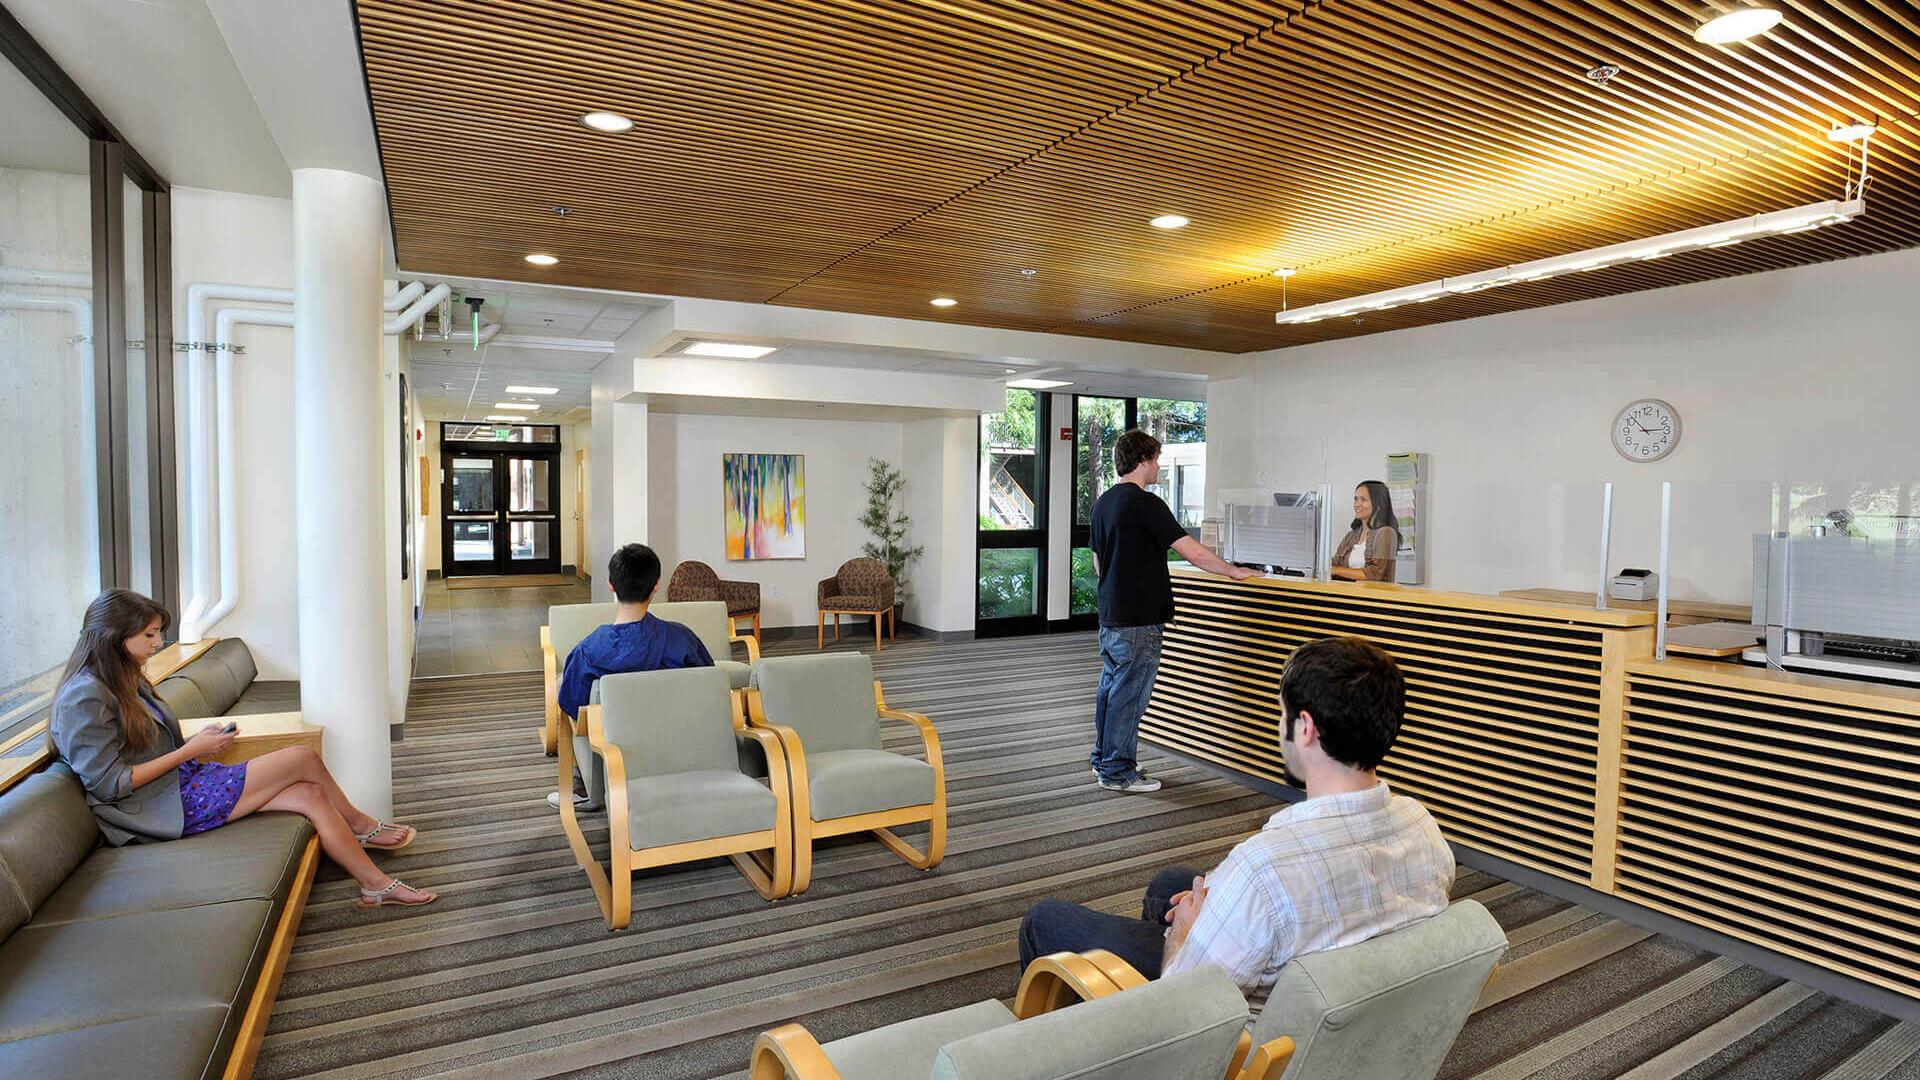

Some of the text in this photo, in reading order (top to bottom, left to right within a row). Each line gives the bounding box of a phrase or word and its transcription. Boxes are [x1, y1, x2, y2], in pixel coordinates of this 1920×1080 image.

[1634, 410, 1641, 418] 11
[1643, 406, 1653, 416] 12
[1624, 417, 1635, 426] 10
[1661, 415, 1668, 425] 2
[1623, 427, 1630, 436] 9
[1663, 425, 1671, 435] 3
[1625, 436, 1632, 445] 8
[1660, 435, 1667, 444] 4
[1634, 443, 1639, 452] 7
[1642, 446, 1649, 455] 6
[1652, 442, 1660, 452] 5
